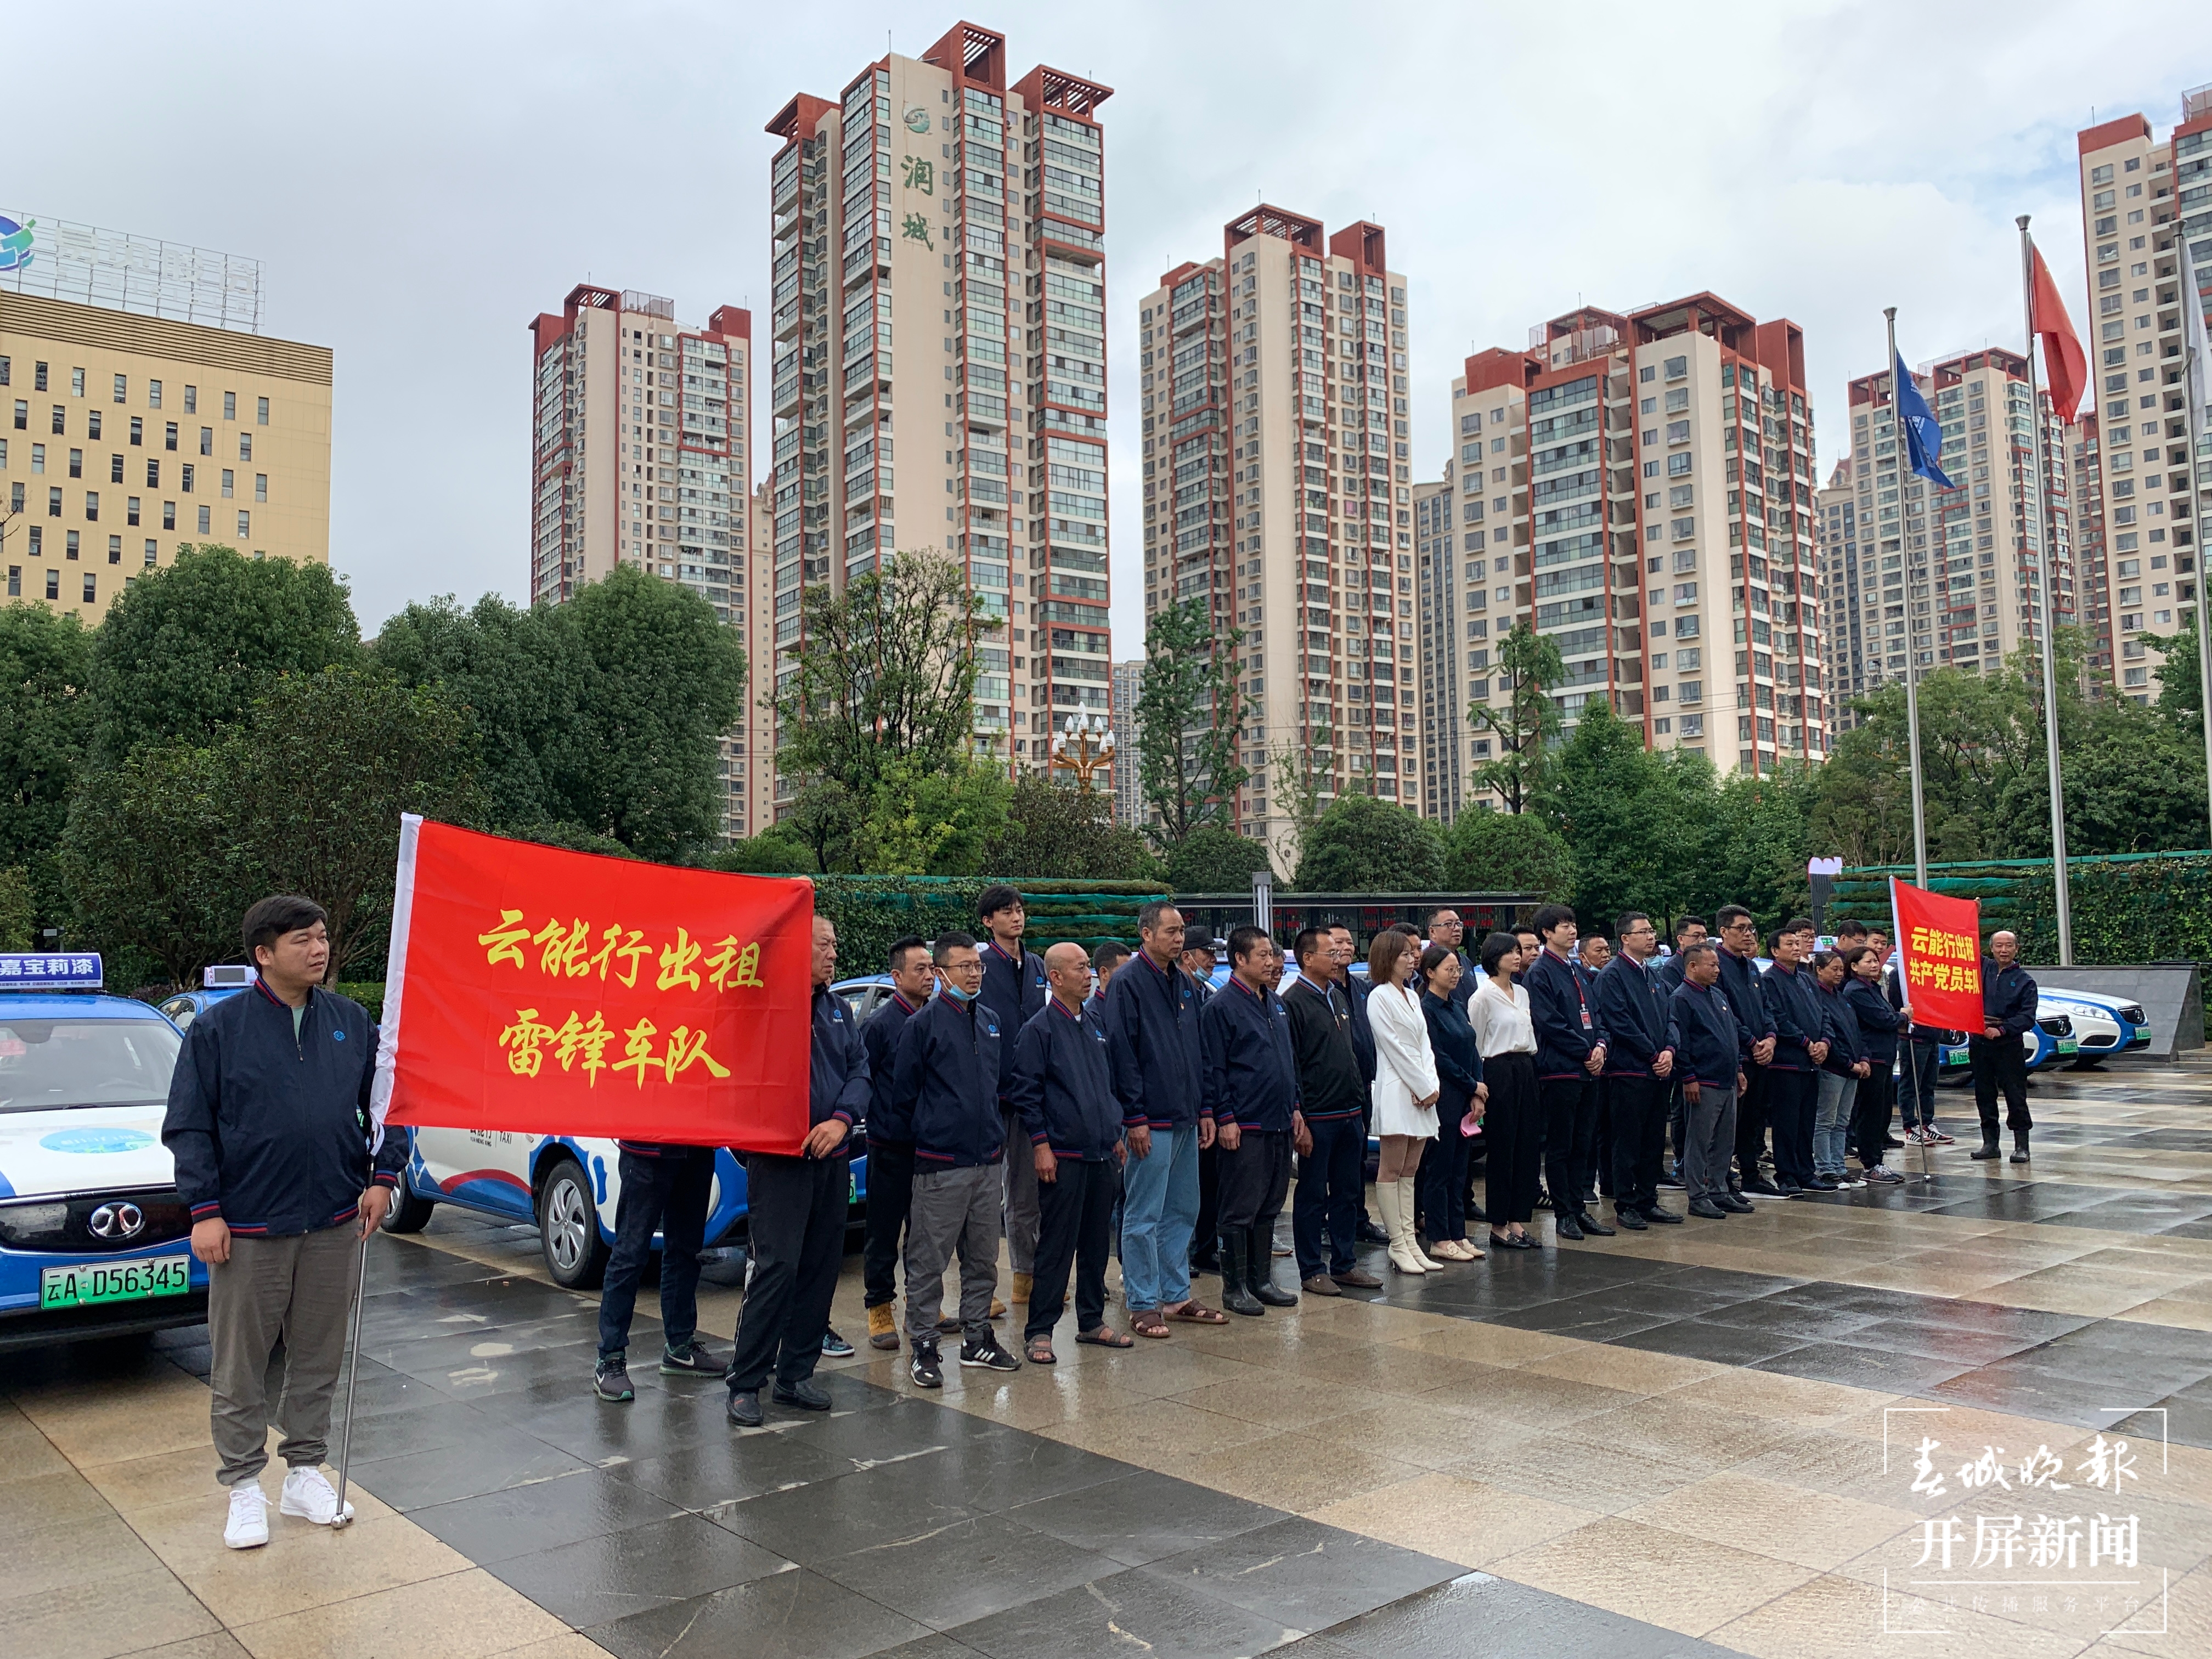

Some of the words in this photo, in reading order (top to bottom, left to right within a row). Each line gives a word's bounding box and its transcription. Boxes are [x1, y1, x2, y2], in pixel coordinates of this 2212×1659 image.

[900, 155, 934, 251] 润城
[55, 226, 255, 295] 易见股份
[0, 958, 94, 976] 嘉宝莉漆
[478, 909, 764, 994] 云能行出租
[1911, 927, 1975, 962] 云能行出租
[1910, 957, 1979, 994] 共产党员车队
[499, 1008, 731, 1091] 雷锋车队
[500, 1131, 512, 1145] TAXI
